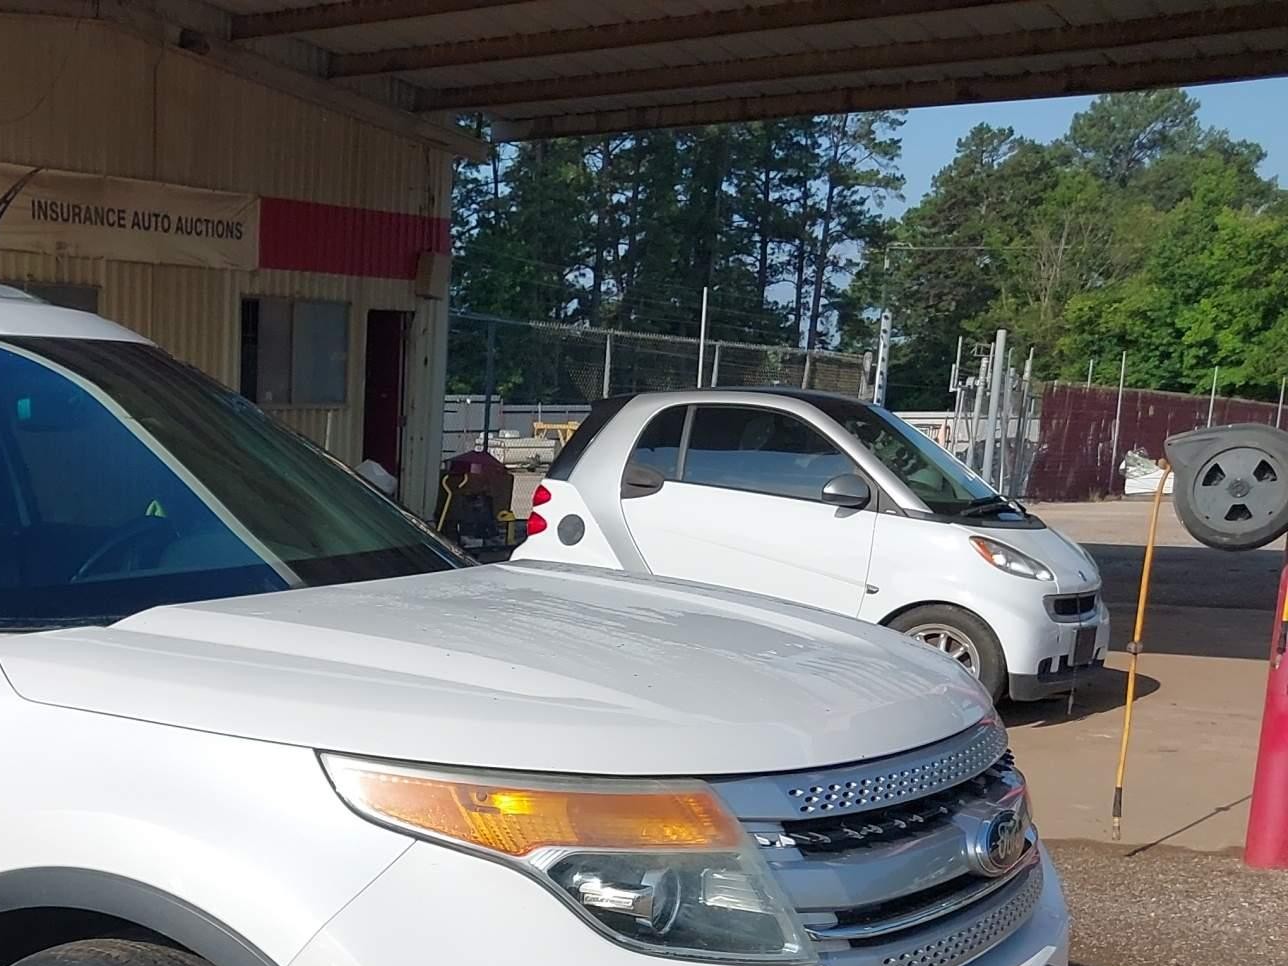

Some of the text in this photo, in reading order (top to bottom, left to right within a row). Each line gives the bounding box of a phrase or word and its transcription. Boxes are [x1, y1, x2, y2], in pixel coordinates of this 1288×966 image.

[31, 199, 244, 241] INSURANCE AUTO AUCTIONS
